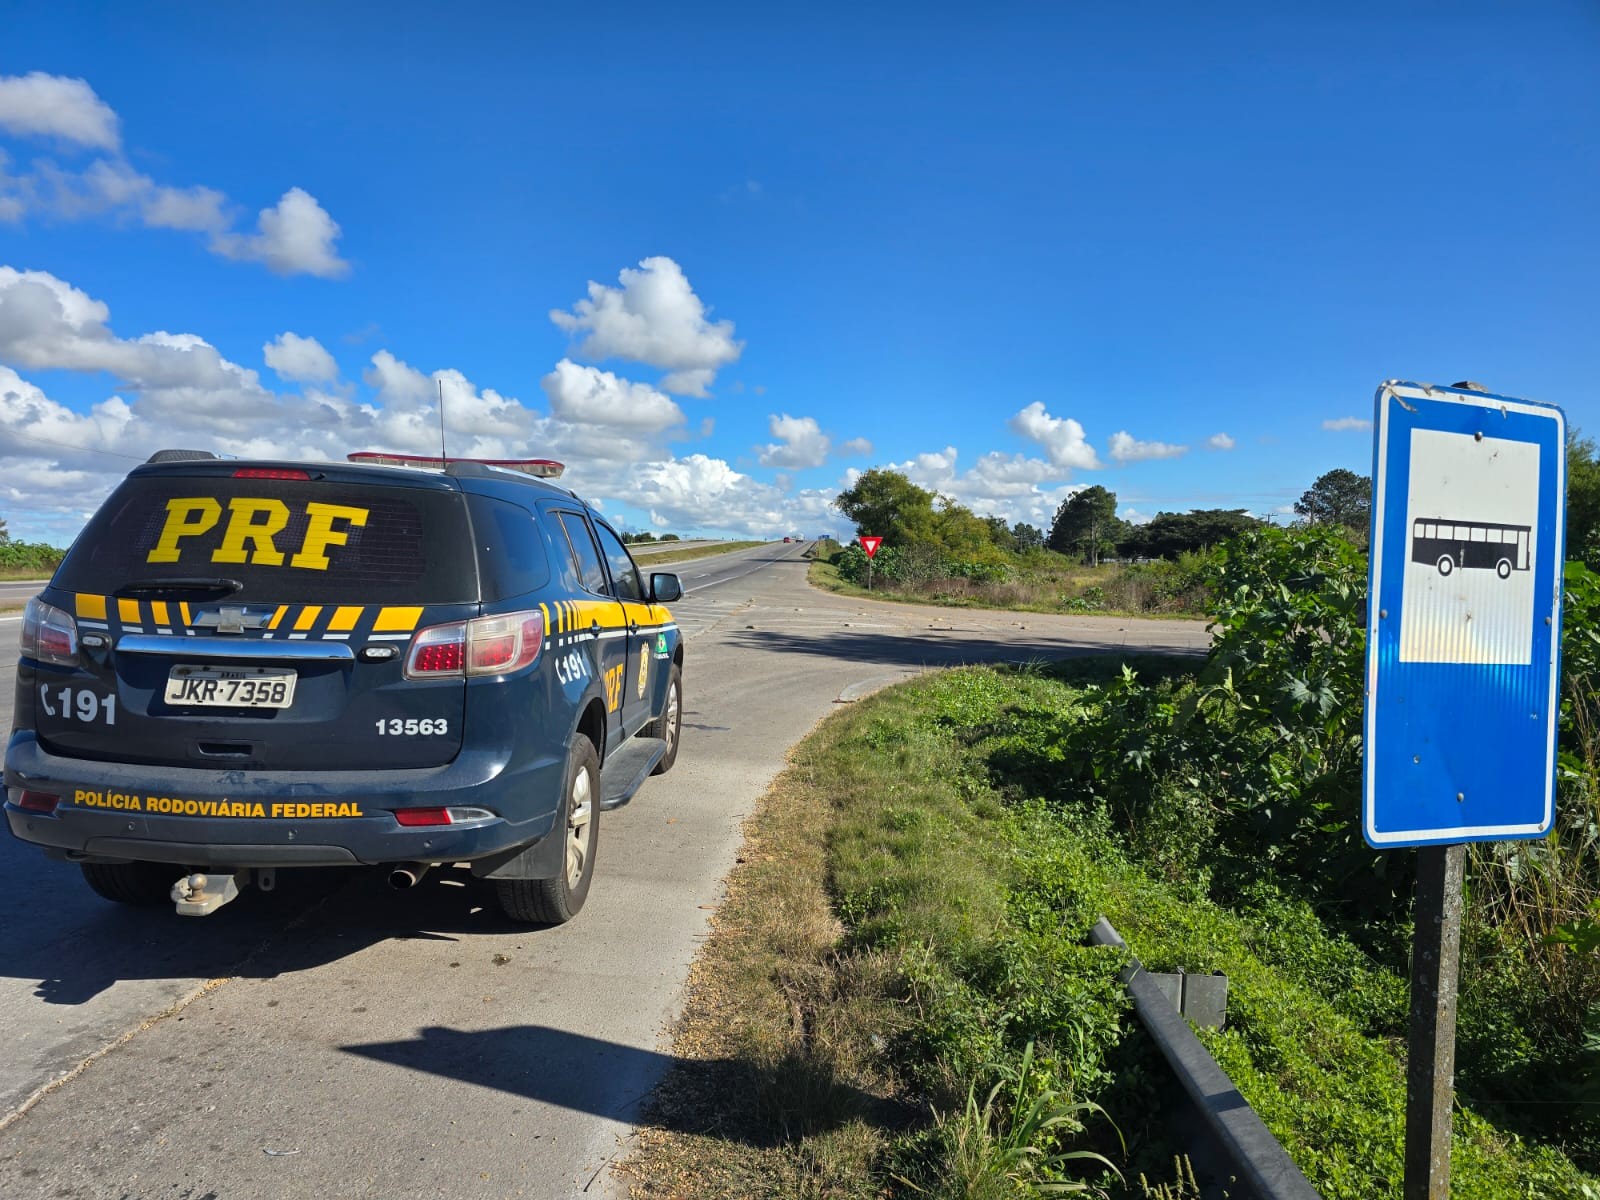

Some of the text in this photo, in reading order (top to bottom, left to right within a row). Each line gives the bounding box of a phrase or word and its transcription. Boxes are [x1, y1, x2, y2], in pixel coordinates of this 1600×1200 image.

[147, 497, 369, 570] PRF
[562, 652, 587, 682] 191
[57, 687, 116, 725] 191
[375, 718, 448, 735] 13563
[74, 789, 363, 818] POLÍCIA RODOVIÁRIA FEDERAL
